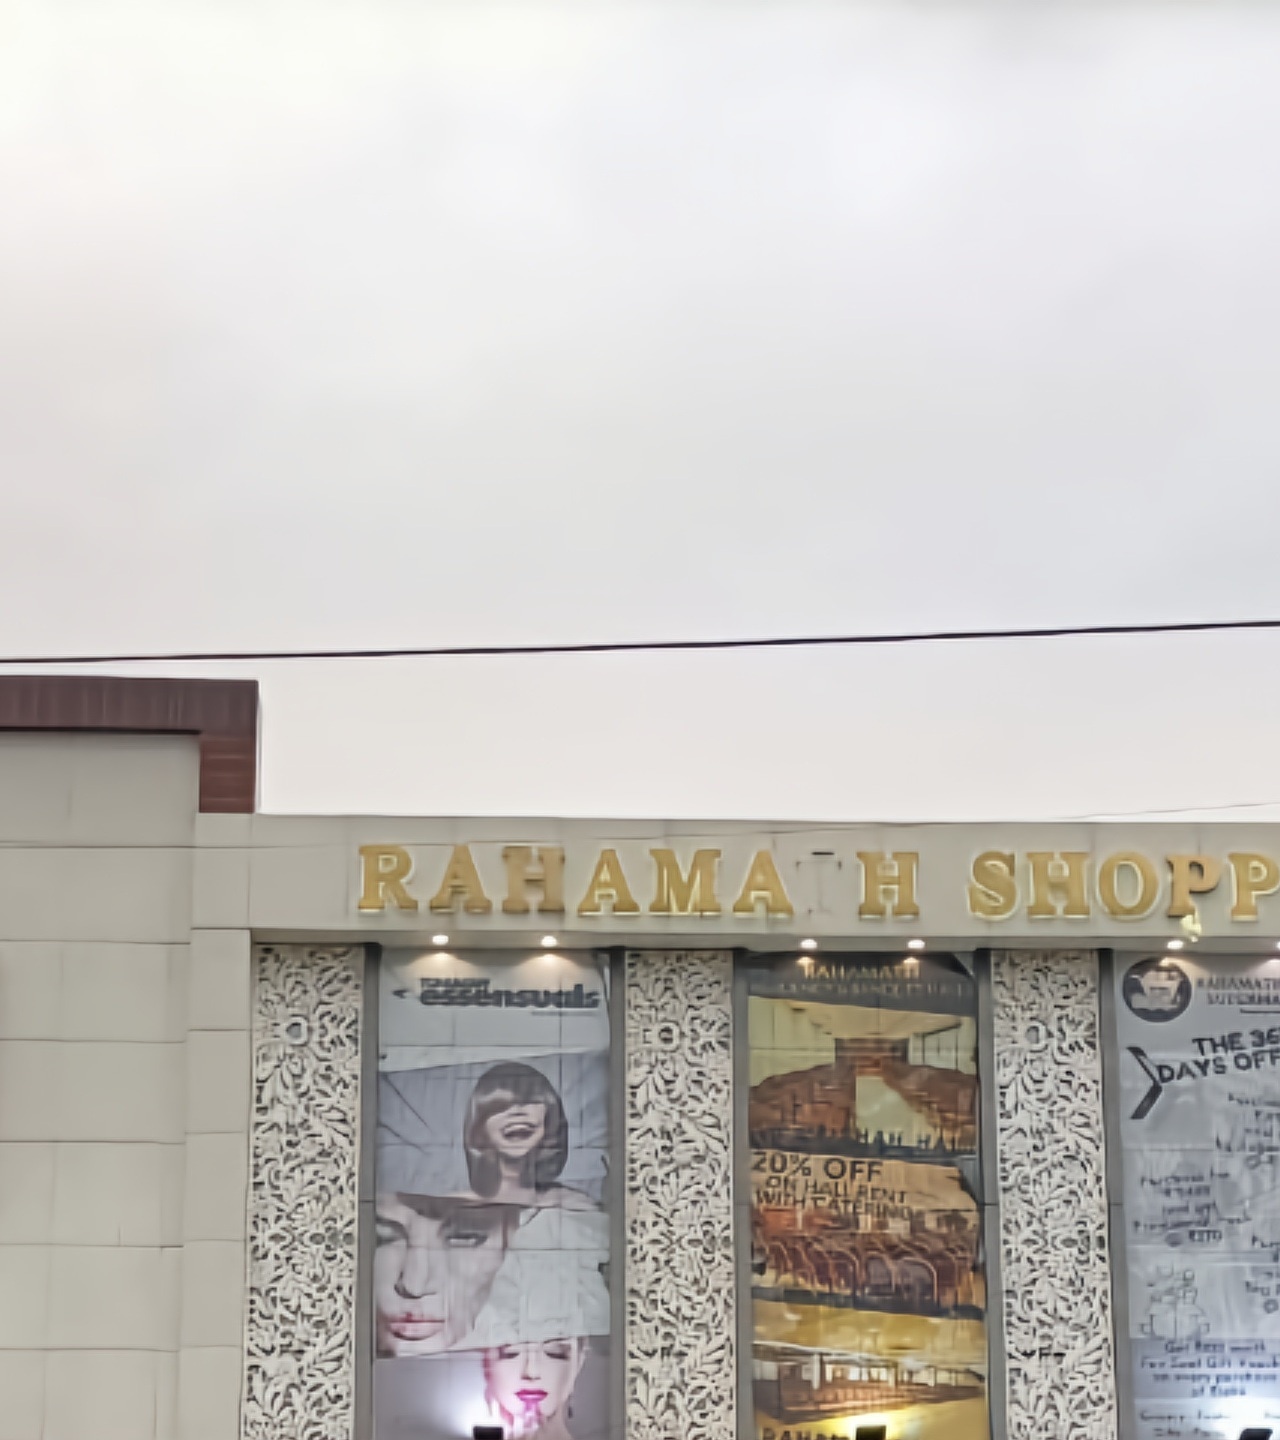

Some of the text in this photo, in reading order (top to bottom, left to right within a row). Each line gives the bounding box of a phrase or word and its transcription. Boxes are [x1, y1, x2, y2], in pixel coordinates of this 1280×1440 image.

[357, 843, 920, 918] RAHAMAH
[1191, 1031, 1246, 1057] THE
[1155, 1056, 1228, 1084] DAYS
[751, 1151, 885, 1182] 20% OFF
